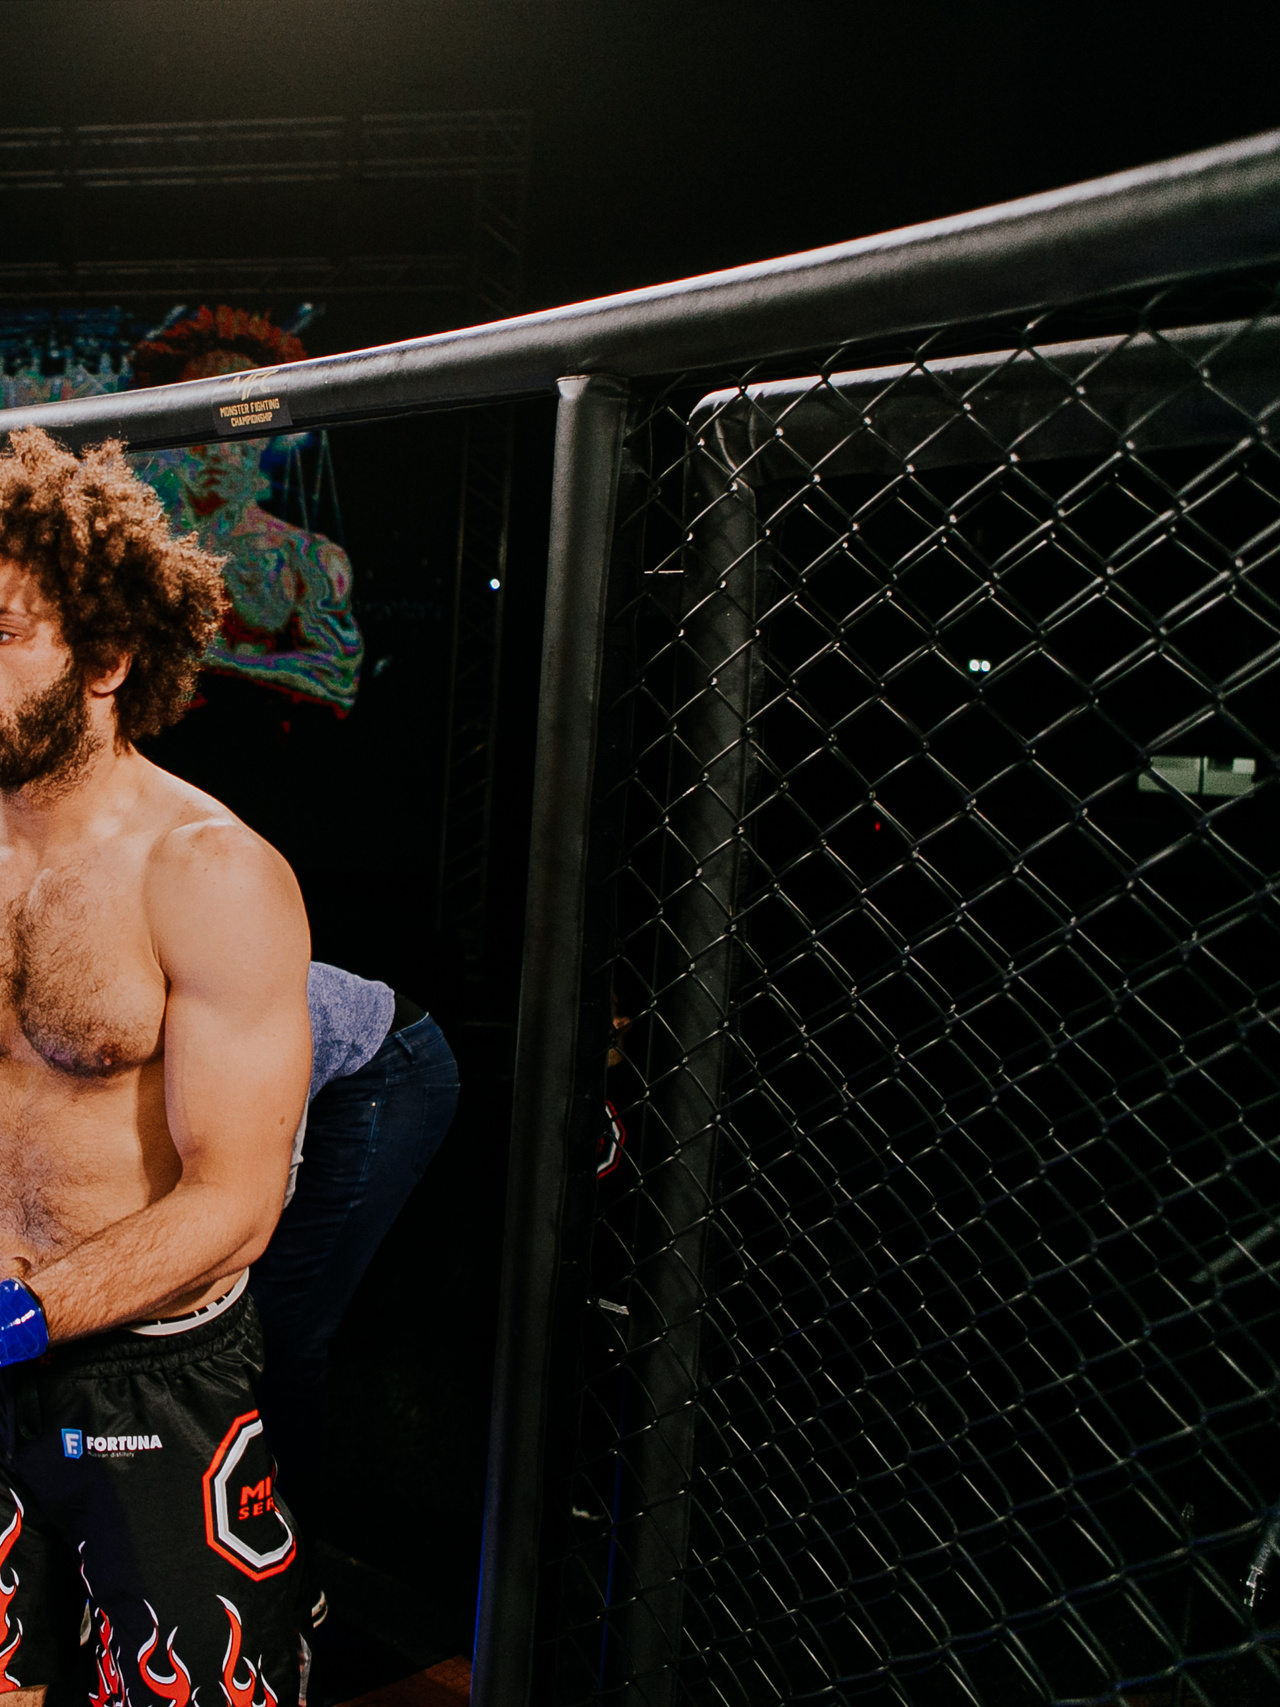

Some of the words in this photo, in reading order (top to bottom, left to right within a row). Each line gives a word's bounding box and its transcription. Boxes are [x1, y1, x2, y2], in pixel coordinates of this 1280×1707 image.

[220, 404, 250, 418] MONSTER
[250, 398, 280, 413] FIGHTING
[231, 412, 273, 427] CHAMPIONSHIP
[86, 1435, 163, 1452] FORTUNA
